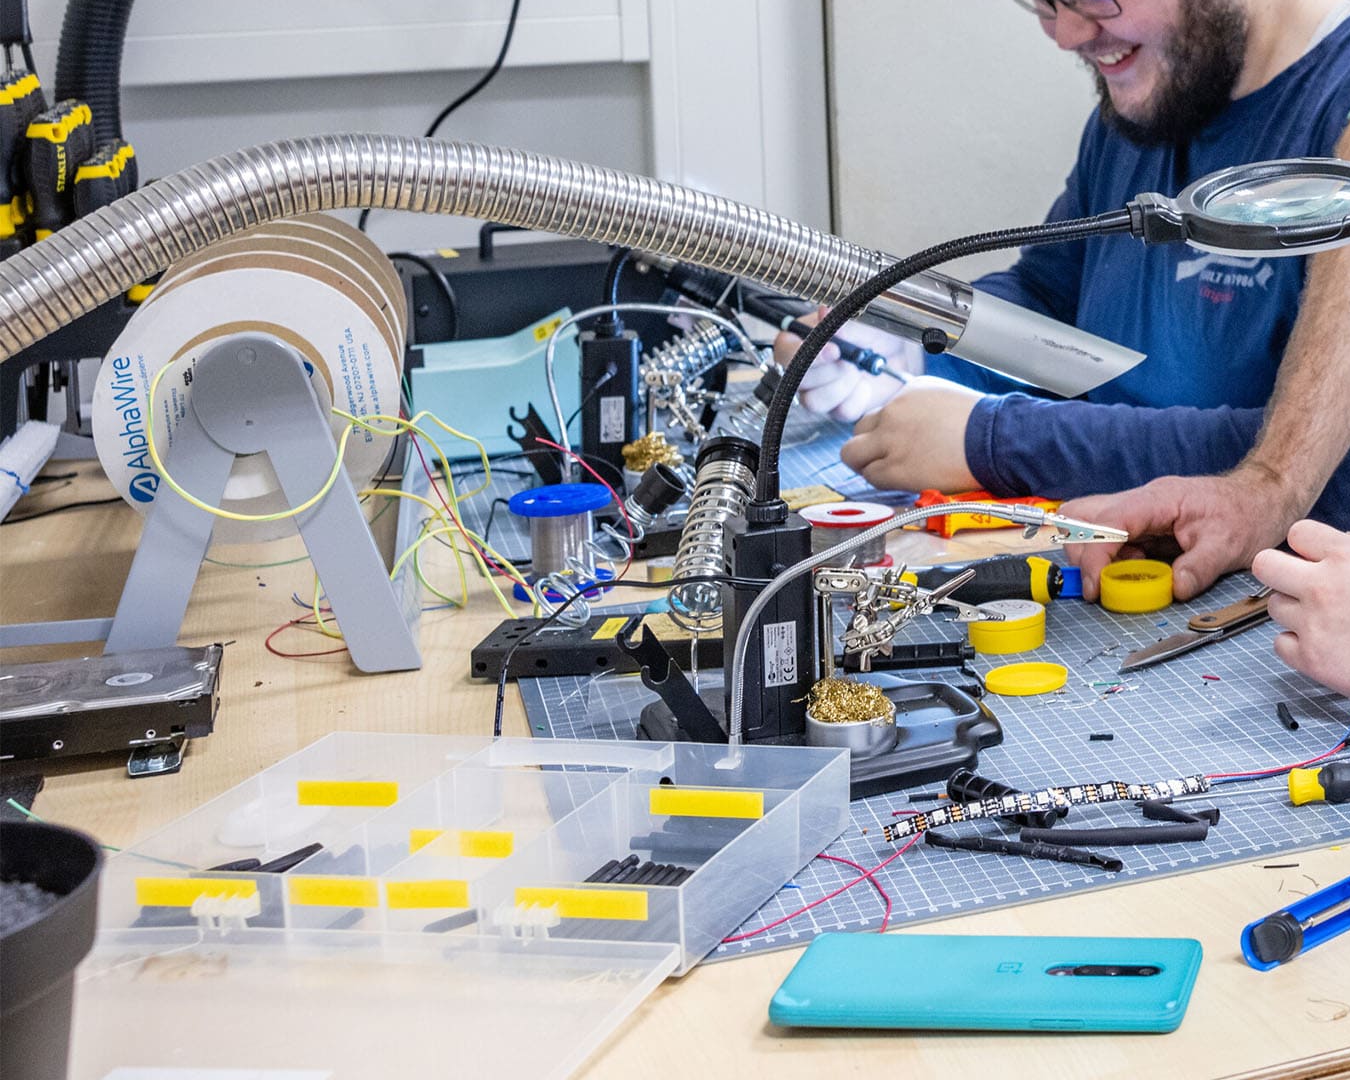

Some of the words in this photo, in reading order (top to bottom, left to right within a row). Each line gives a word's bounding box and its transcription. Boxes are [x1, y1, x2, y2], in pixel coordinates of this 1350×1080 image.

[56, 144, 66, 192] STANLEY
[344, 327, 354, 345] USA
[337, 344, 348, 373] Avenue
[348, 346, 362, 391] 07207-0711
[111, 357, 151, 469] AlphaWire
[344, 374, 358, 418] idgerwood
[357, 391, 365, 403] NJ
